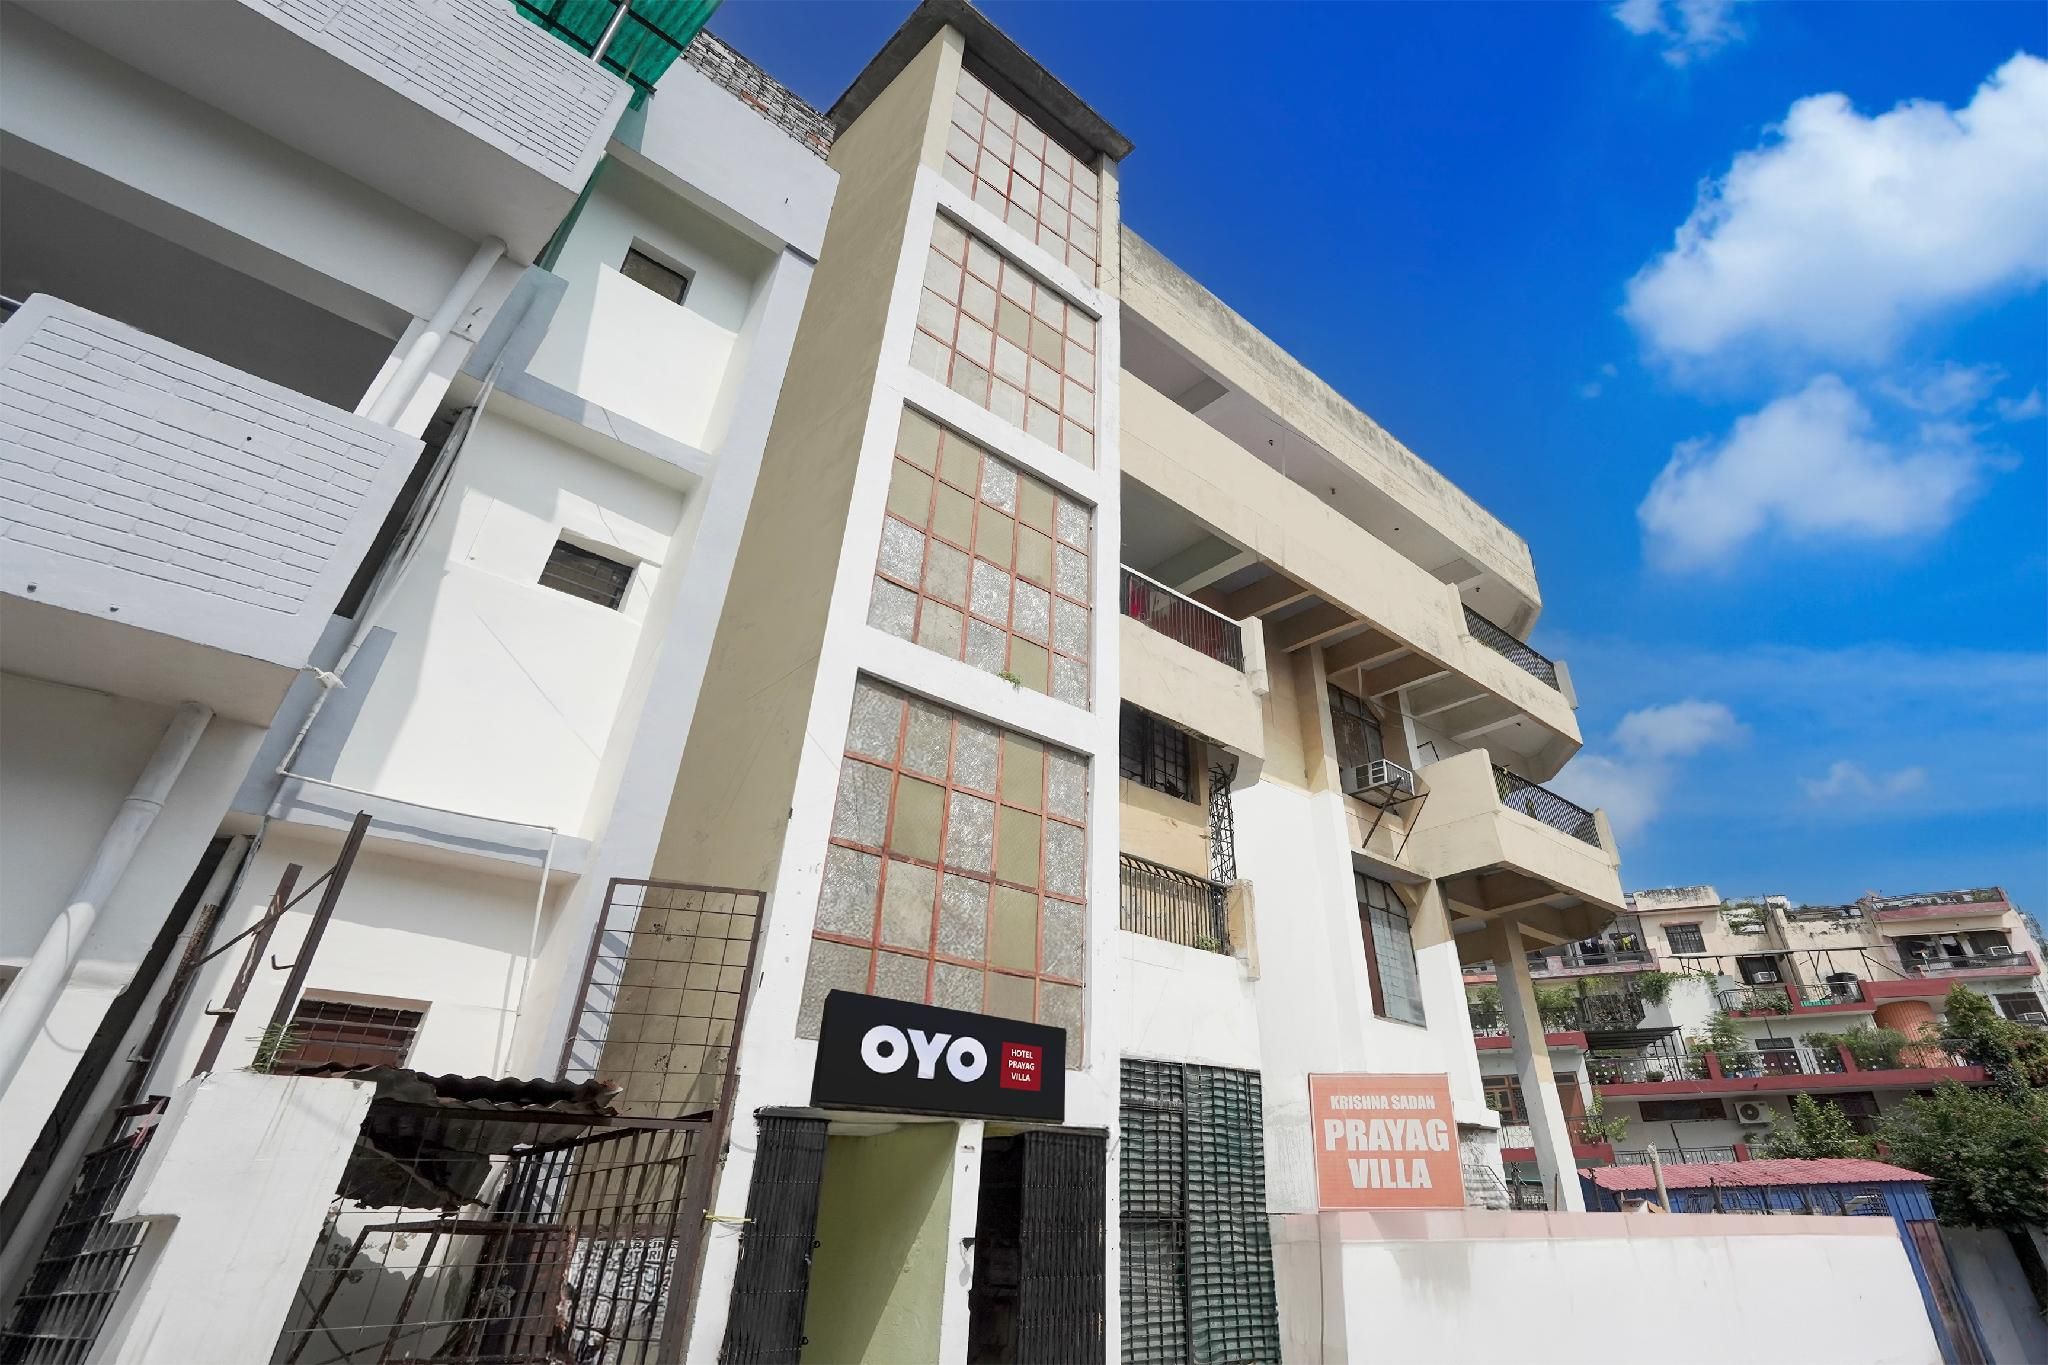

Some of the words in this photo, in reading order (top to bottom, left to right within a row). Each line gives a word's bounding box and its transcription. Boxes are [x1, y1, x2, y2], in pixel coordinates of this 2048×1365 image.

[861, 1025, 988, 1083] OYO
[1011, 1049, 1034, 1059] HOTEL
[1008, 1060, 1035, 1071] PRAYAG
[1011, 1072, 1031, 1082] VILLA
[1330, 1095, 1389, 1110] KRISHNA
[1391, 1095, 1435, 1110] SADAN
[1323, 1118, 1450, 1152] PRAYAG
[1348, 1158, 1433, 1189] VILLA
